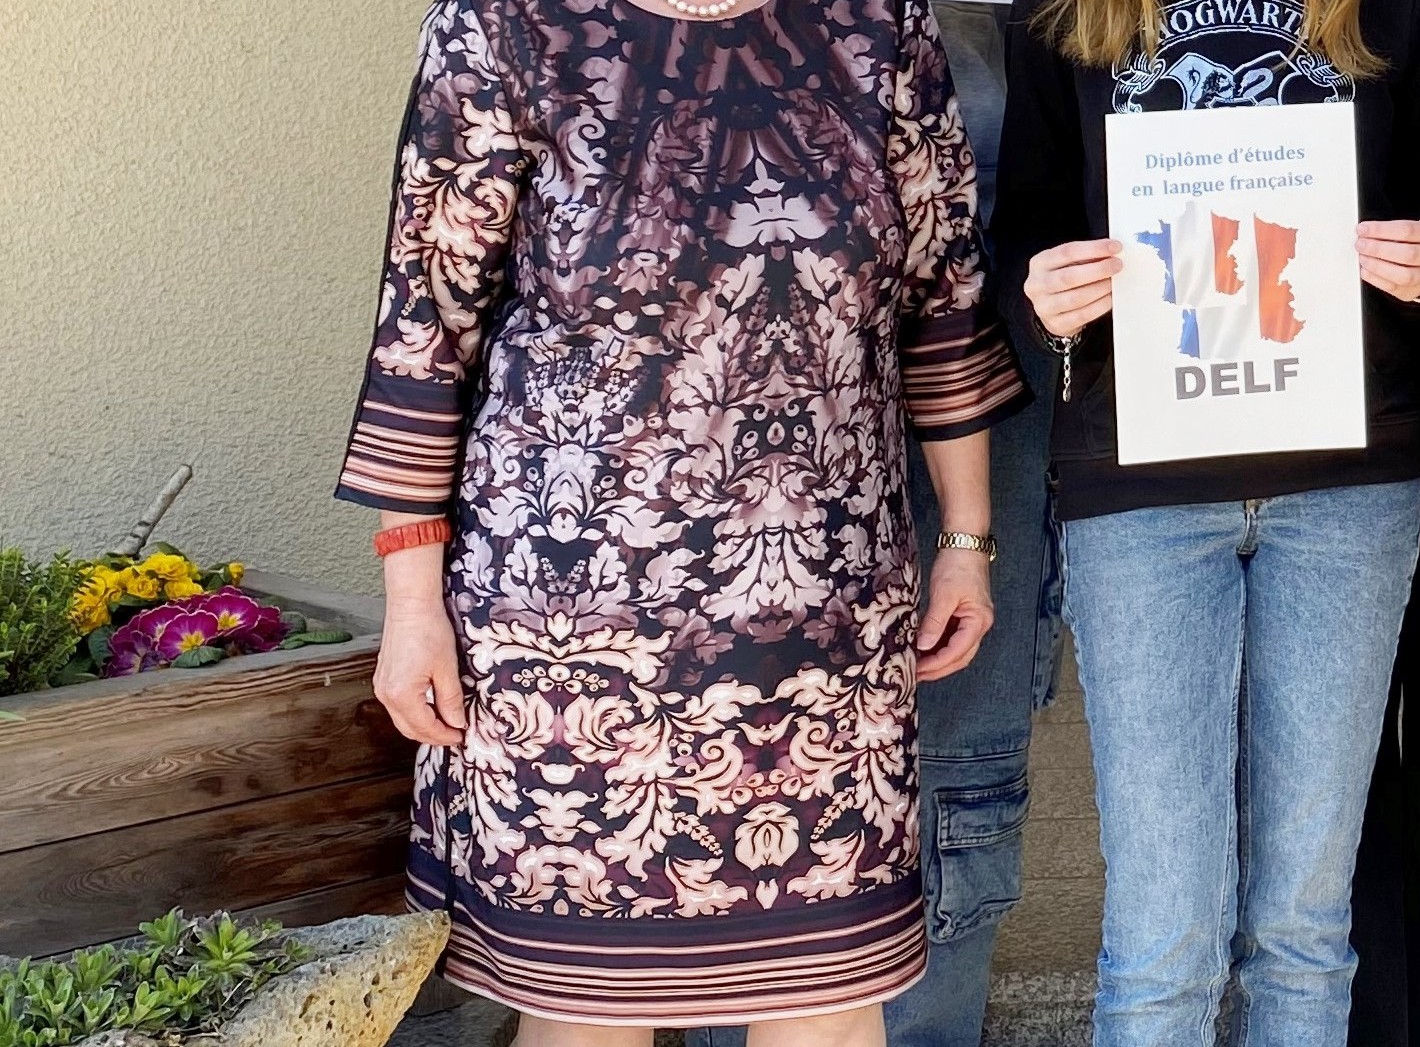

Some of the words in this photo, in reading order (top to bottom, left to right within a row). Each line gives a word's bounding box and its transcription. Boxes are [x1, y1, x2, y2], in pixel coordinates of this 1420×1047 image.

[1145, 151, 1222, 173] Diplôme
[1131, 183, 1153, 197] en
[1162, 178, 1225, 197] langue
[1229, 172, 1314, 193] française
[1174, 356, 1301, 401] DELF
